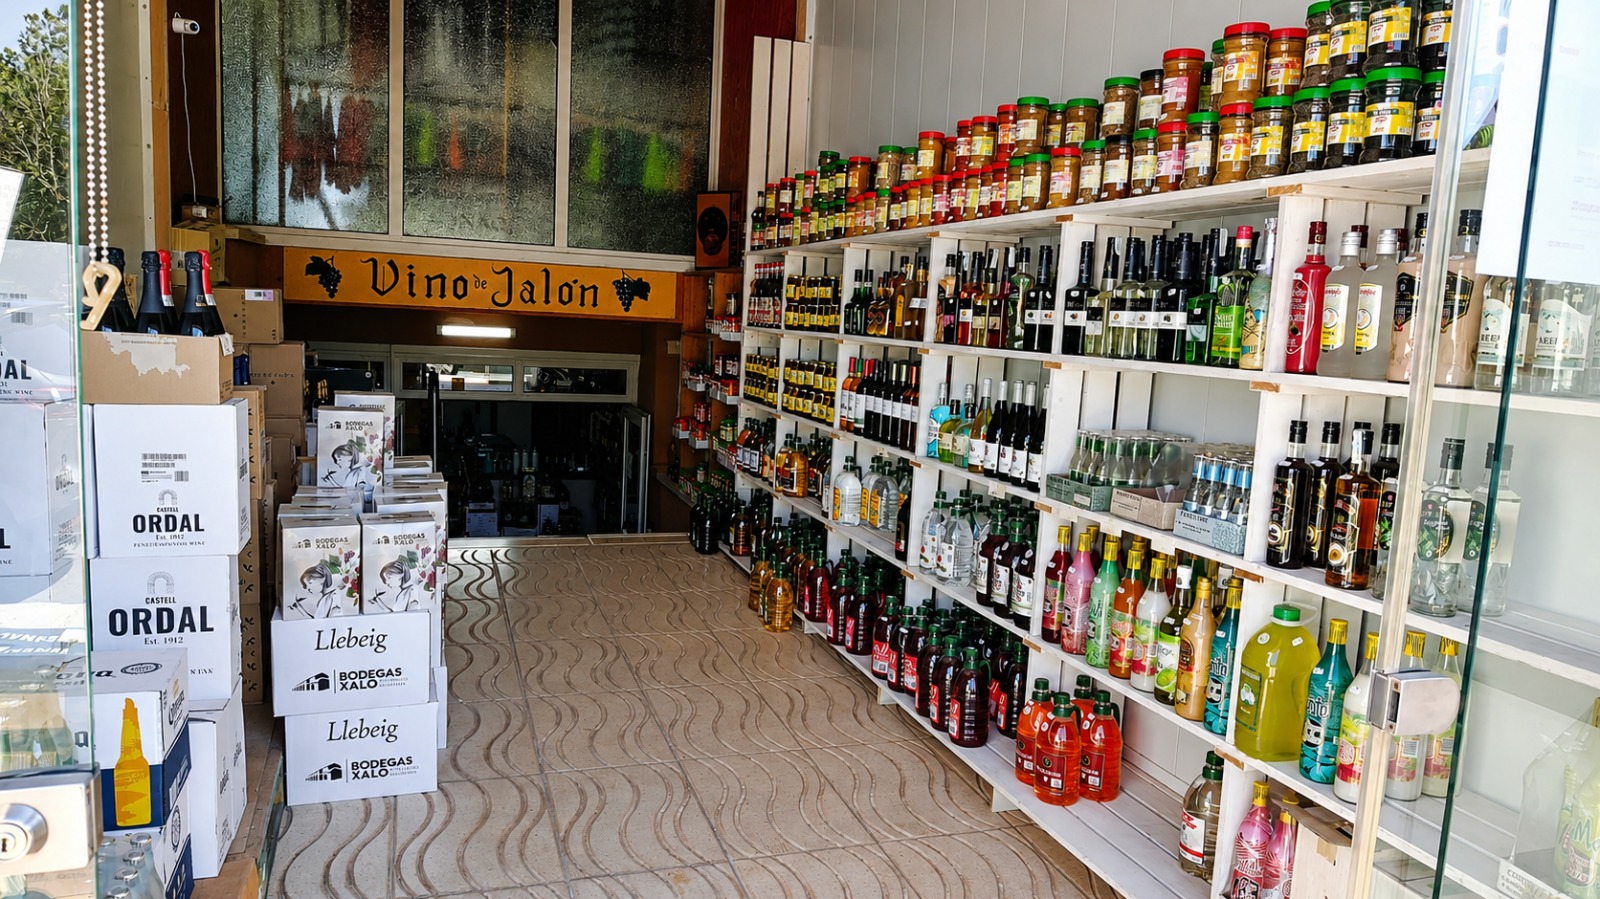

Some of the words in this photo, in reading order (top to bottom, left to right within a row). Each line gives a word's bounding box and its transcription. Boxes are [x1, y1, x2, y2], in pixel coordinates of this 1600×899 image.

[360, 257, 469, 301] Vino
[474, 273, 488, 291] de
[132, 513, 205, 534] ORDAL
[393, 533, 425, 541] BODEGAS
[145, 596, 177, 605] CASTELL
[108, 606, 215, 637] ORDAL
[143, 637, 160, 646] Est.
[163, 636, 184, 645] 1912
[314, 627, 388, 654] Llebeig
[339, 667, 402, 681] BODEGAS
[339, 679, 378, 692] XALO
[326, 718, 399, 743] Llebeig
[351, 756, 413, 771] BODEGAS
[351, 768, 389, 781] XALO
